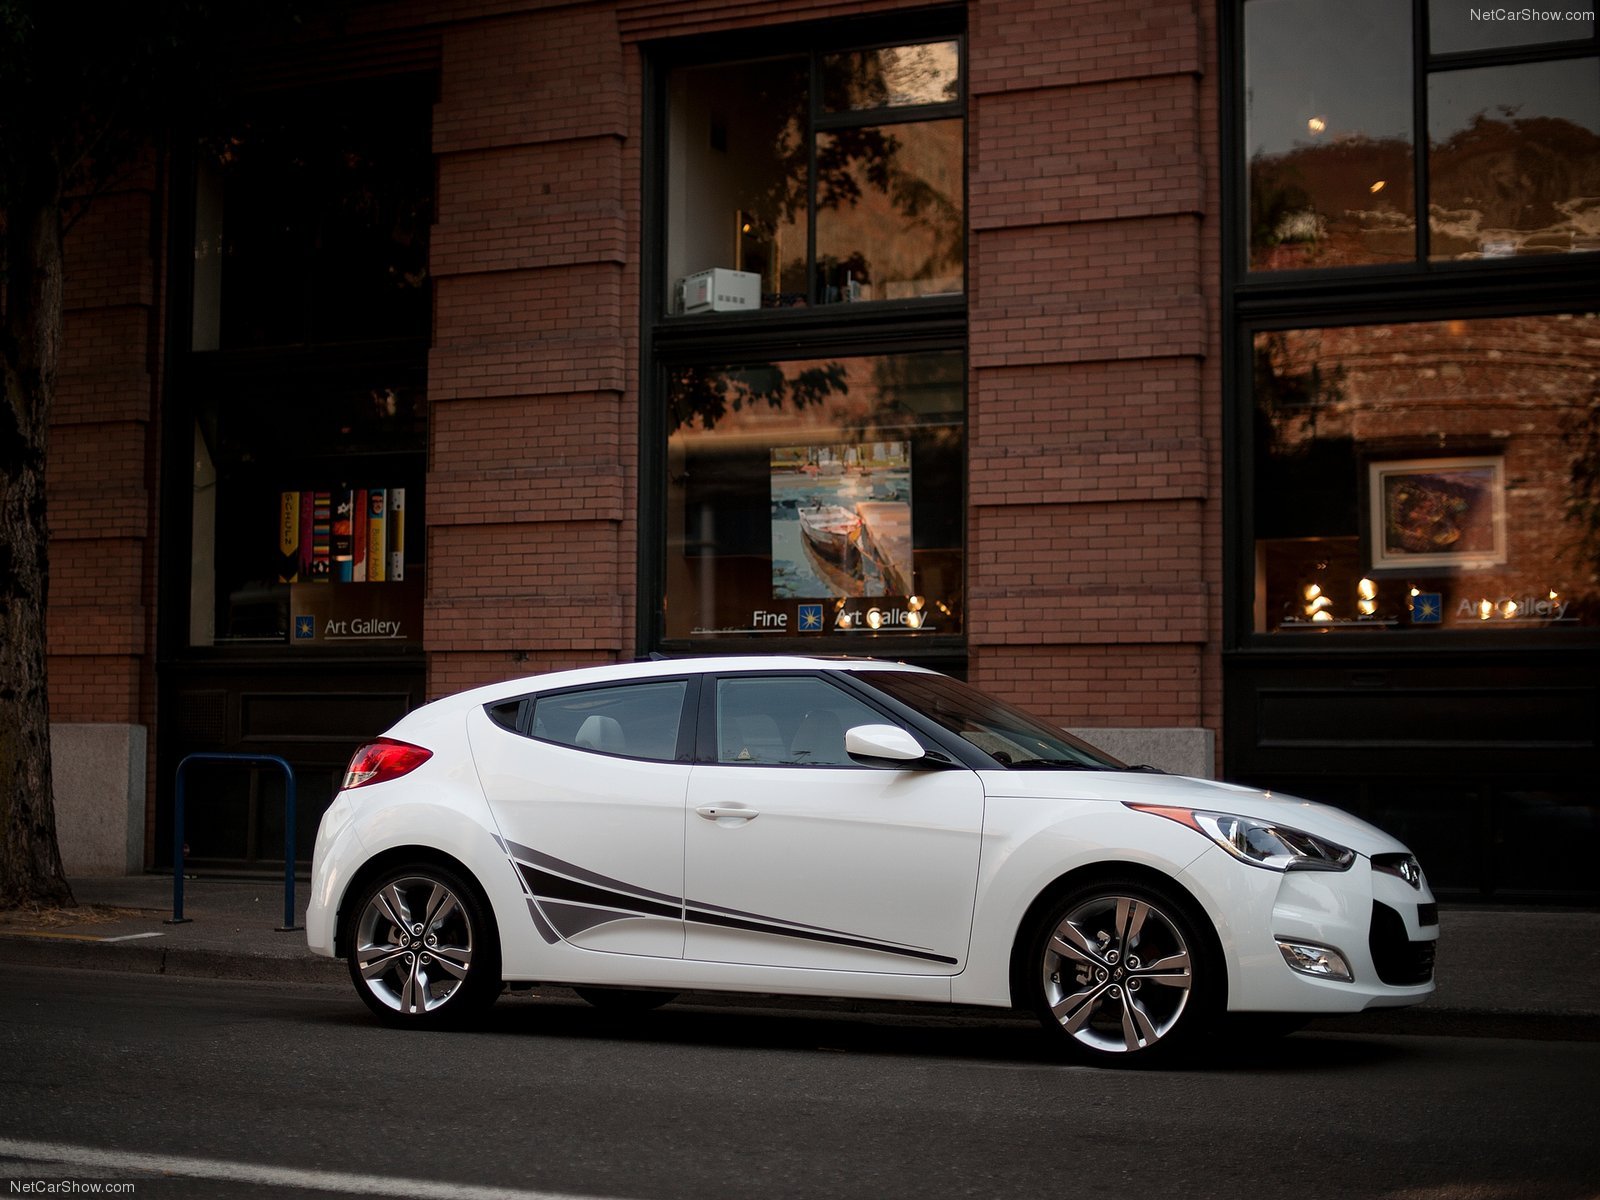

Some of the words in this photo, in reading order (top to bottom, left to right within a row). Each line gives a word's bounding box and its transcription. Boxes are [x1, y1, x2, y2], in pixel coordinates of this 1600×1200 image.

[324, 619, 347, 635] Art
[350, 618, 401, 638] Gallery
[752, 610, 788, 627] Fine
[866, 607, 928, 629] Galley
